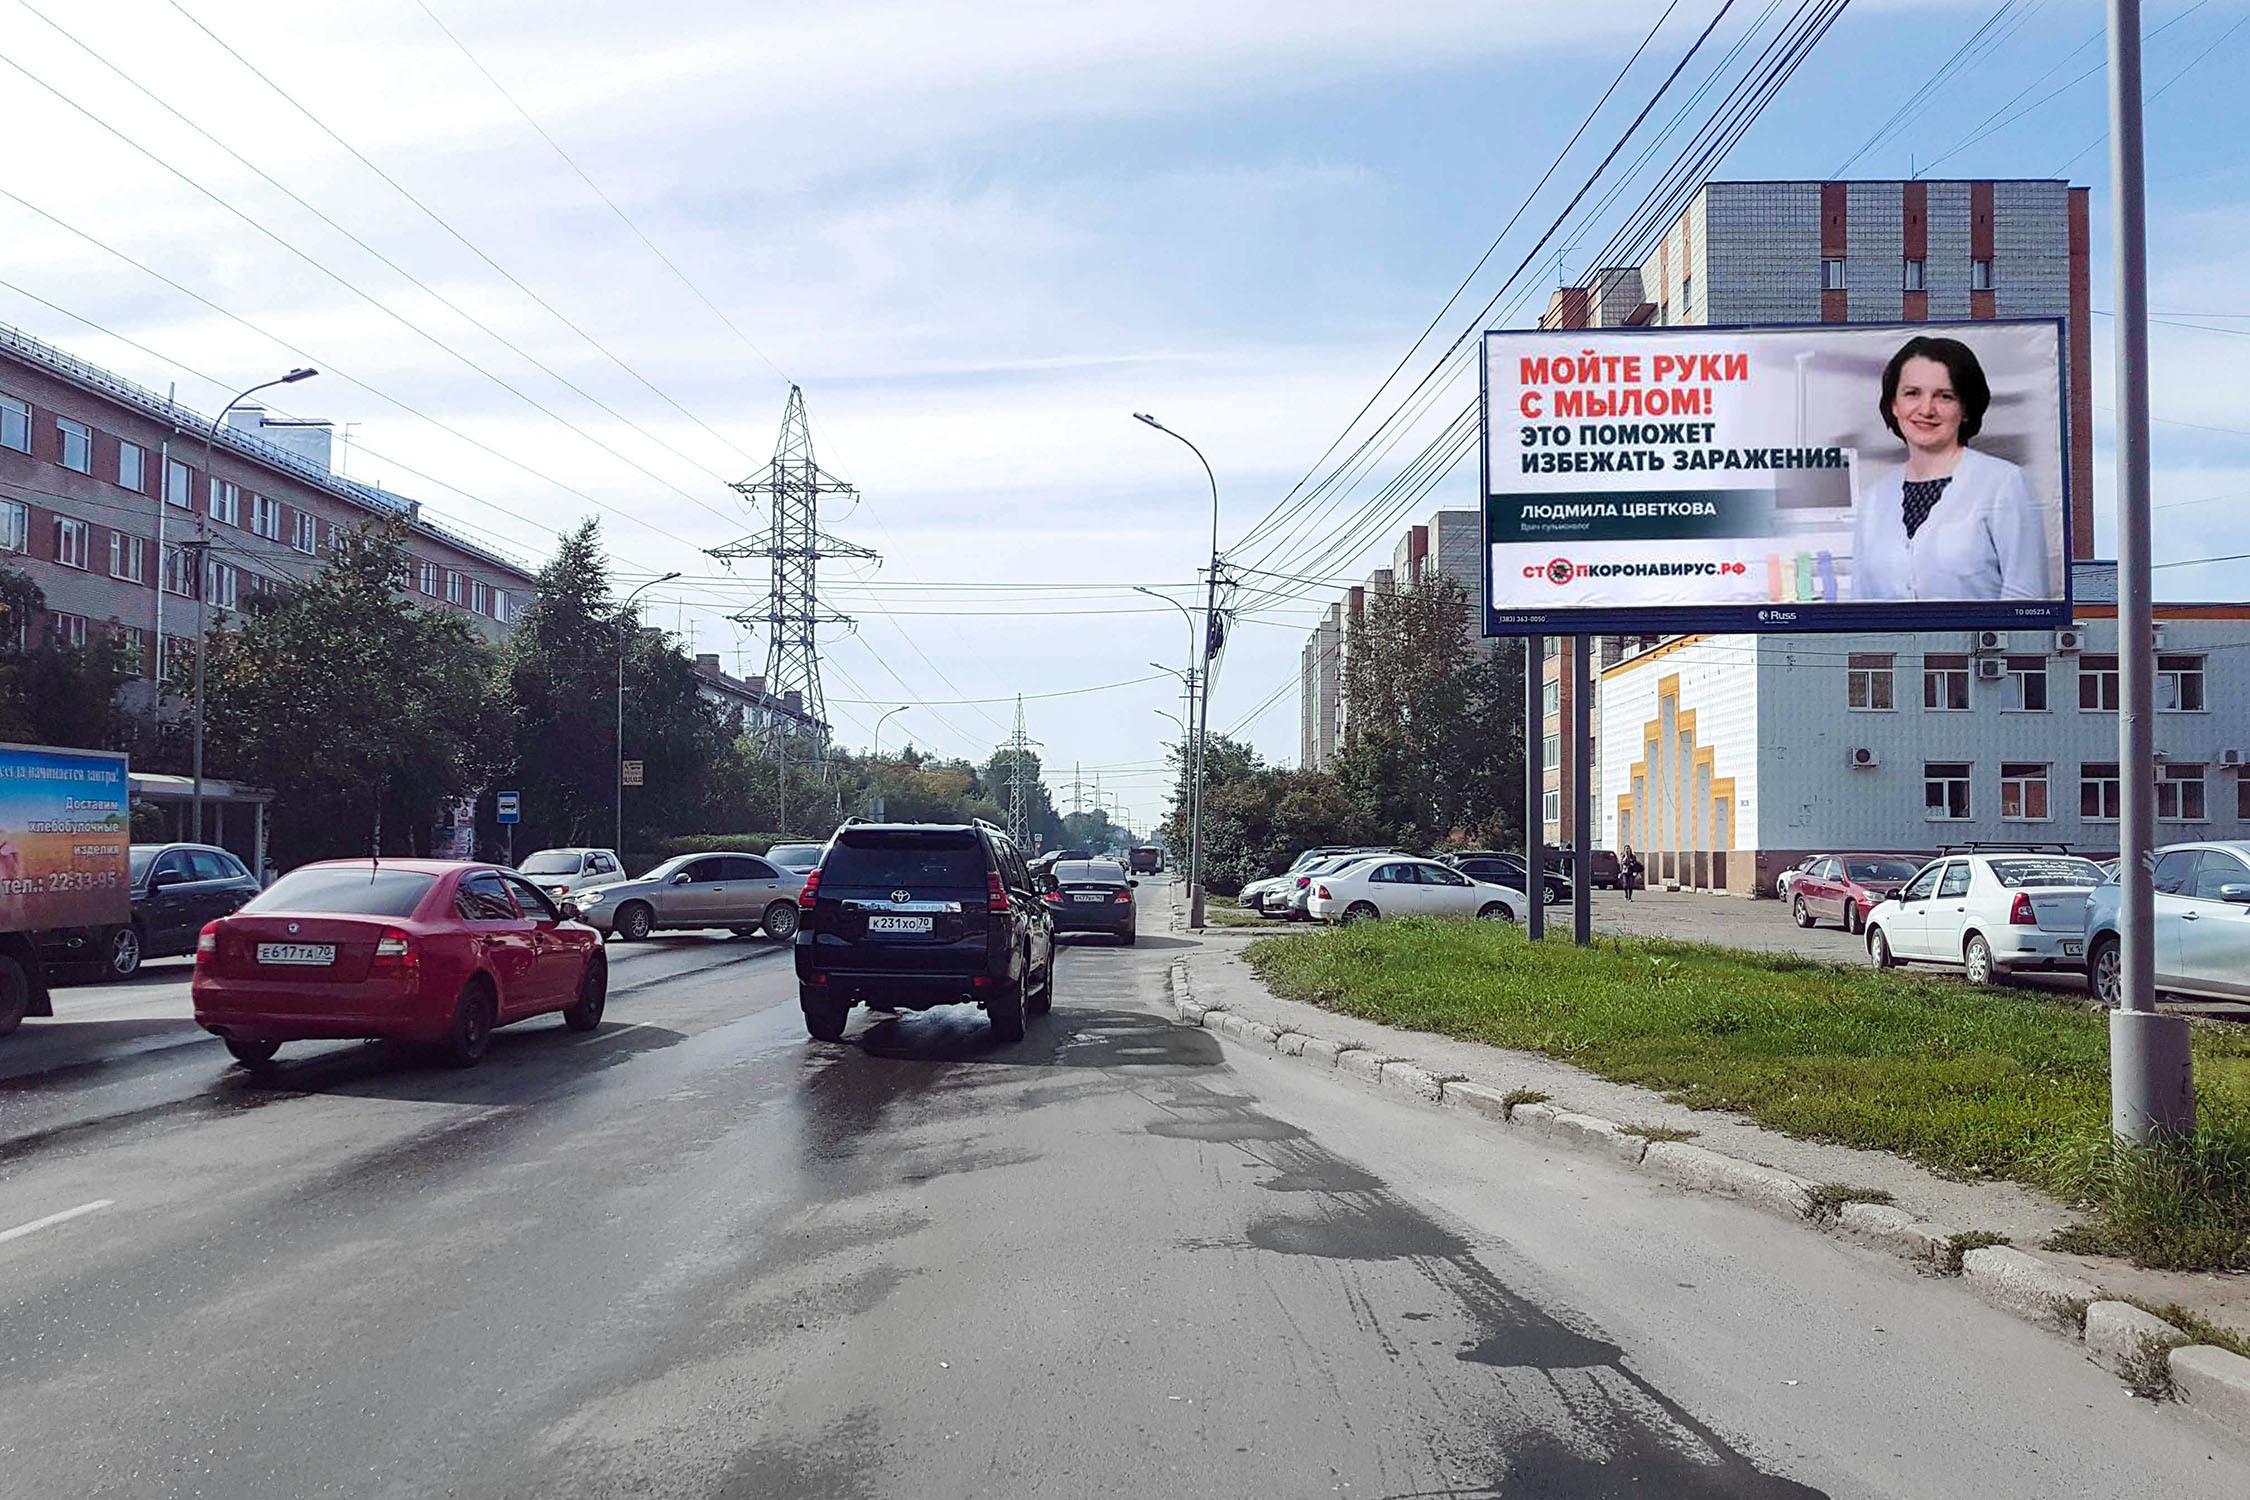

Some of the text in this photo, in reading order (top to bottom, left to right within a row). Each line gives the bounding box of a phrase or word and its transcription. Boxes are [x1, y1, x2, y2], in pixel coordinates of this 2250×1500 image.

[1520, 350, 1748, 385] МОЙТЕ РУКИ
[1520, 388, 1713, 419] С МЫЛОМ!
[1520, 422, 1715, 447] ЭТО ПОМОЖЕТ
[1521, 447, 1850, 473] ИЗБЕЖАТЬ ЗАРАЖЕНИЯ.
[1520, 501, 1717, 520] ЛЮДМИЛА ЦВЕТКОВА
[1770, 610, 1797, 620] Russ
[28, 766, 84, 782] начинается
[65, 797, 118, 811] Доставим
[28, 818, 119, 835] хлебобулочные
[74, 844, 120, 856] изделия
[1, 872, 117, 894] тел.: 22-33-95
[262, 946, 313, 959] Е617ТА
